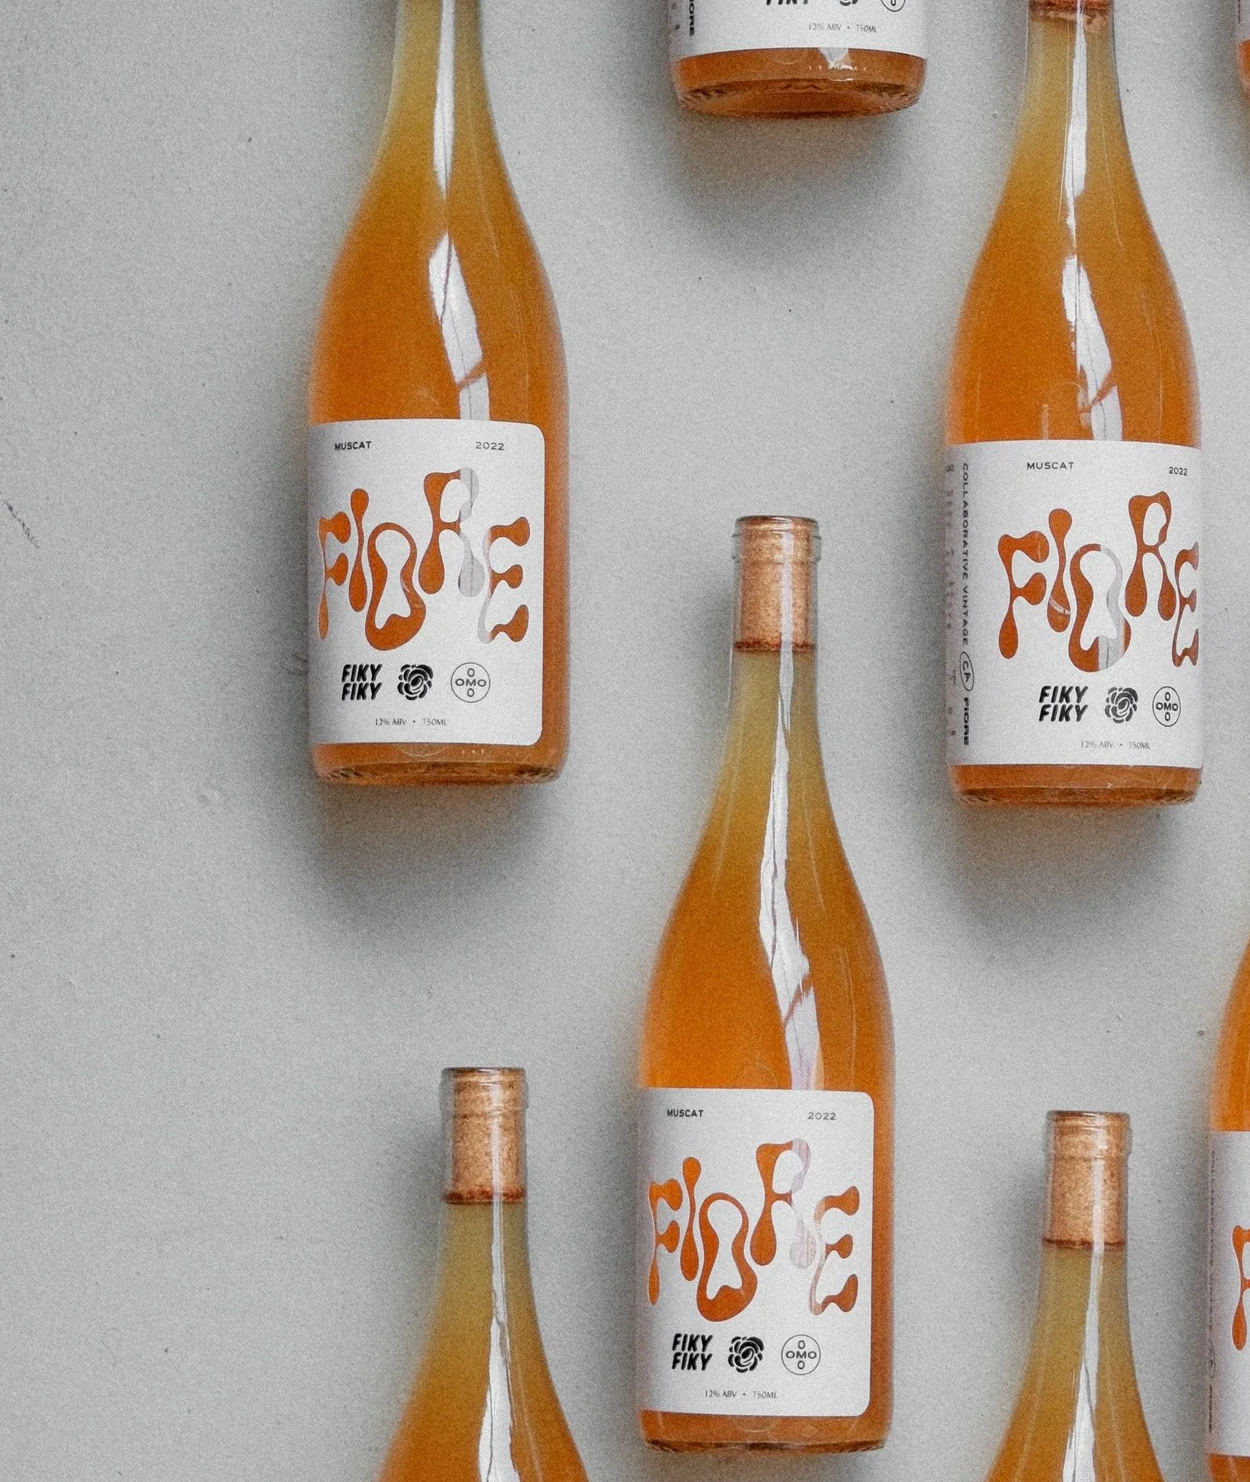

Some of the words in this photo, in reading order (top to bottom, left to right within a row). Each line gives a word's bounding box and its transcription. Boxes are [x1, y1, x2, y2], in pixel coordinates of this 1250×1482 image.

[334, 441, 371, 451] MUSCAT
[476, 442, 504, 451] 2022
[1169, 467, 1187, 476] 2022
[342, 664, 381, 682] FIKY
[342, 683, 381, 700] FIKY
[1039, 686, 1087, 703] FIKY
[1039, 704, 1087, 721] FIKY
[666, 1109, 703, 1117] MUSCAT
[808, 1112, 836, 1120] 2022
[672, 1333, 712, 1352] FIKY
[672, 1352, 712, 1370] FIKY
